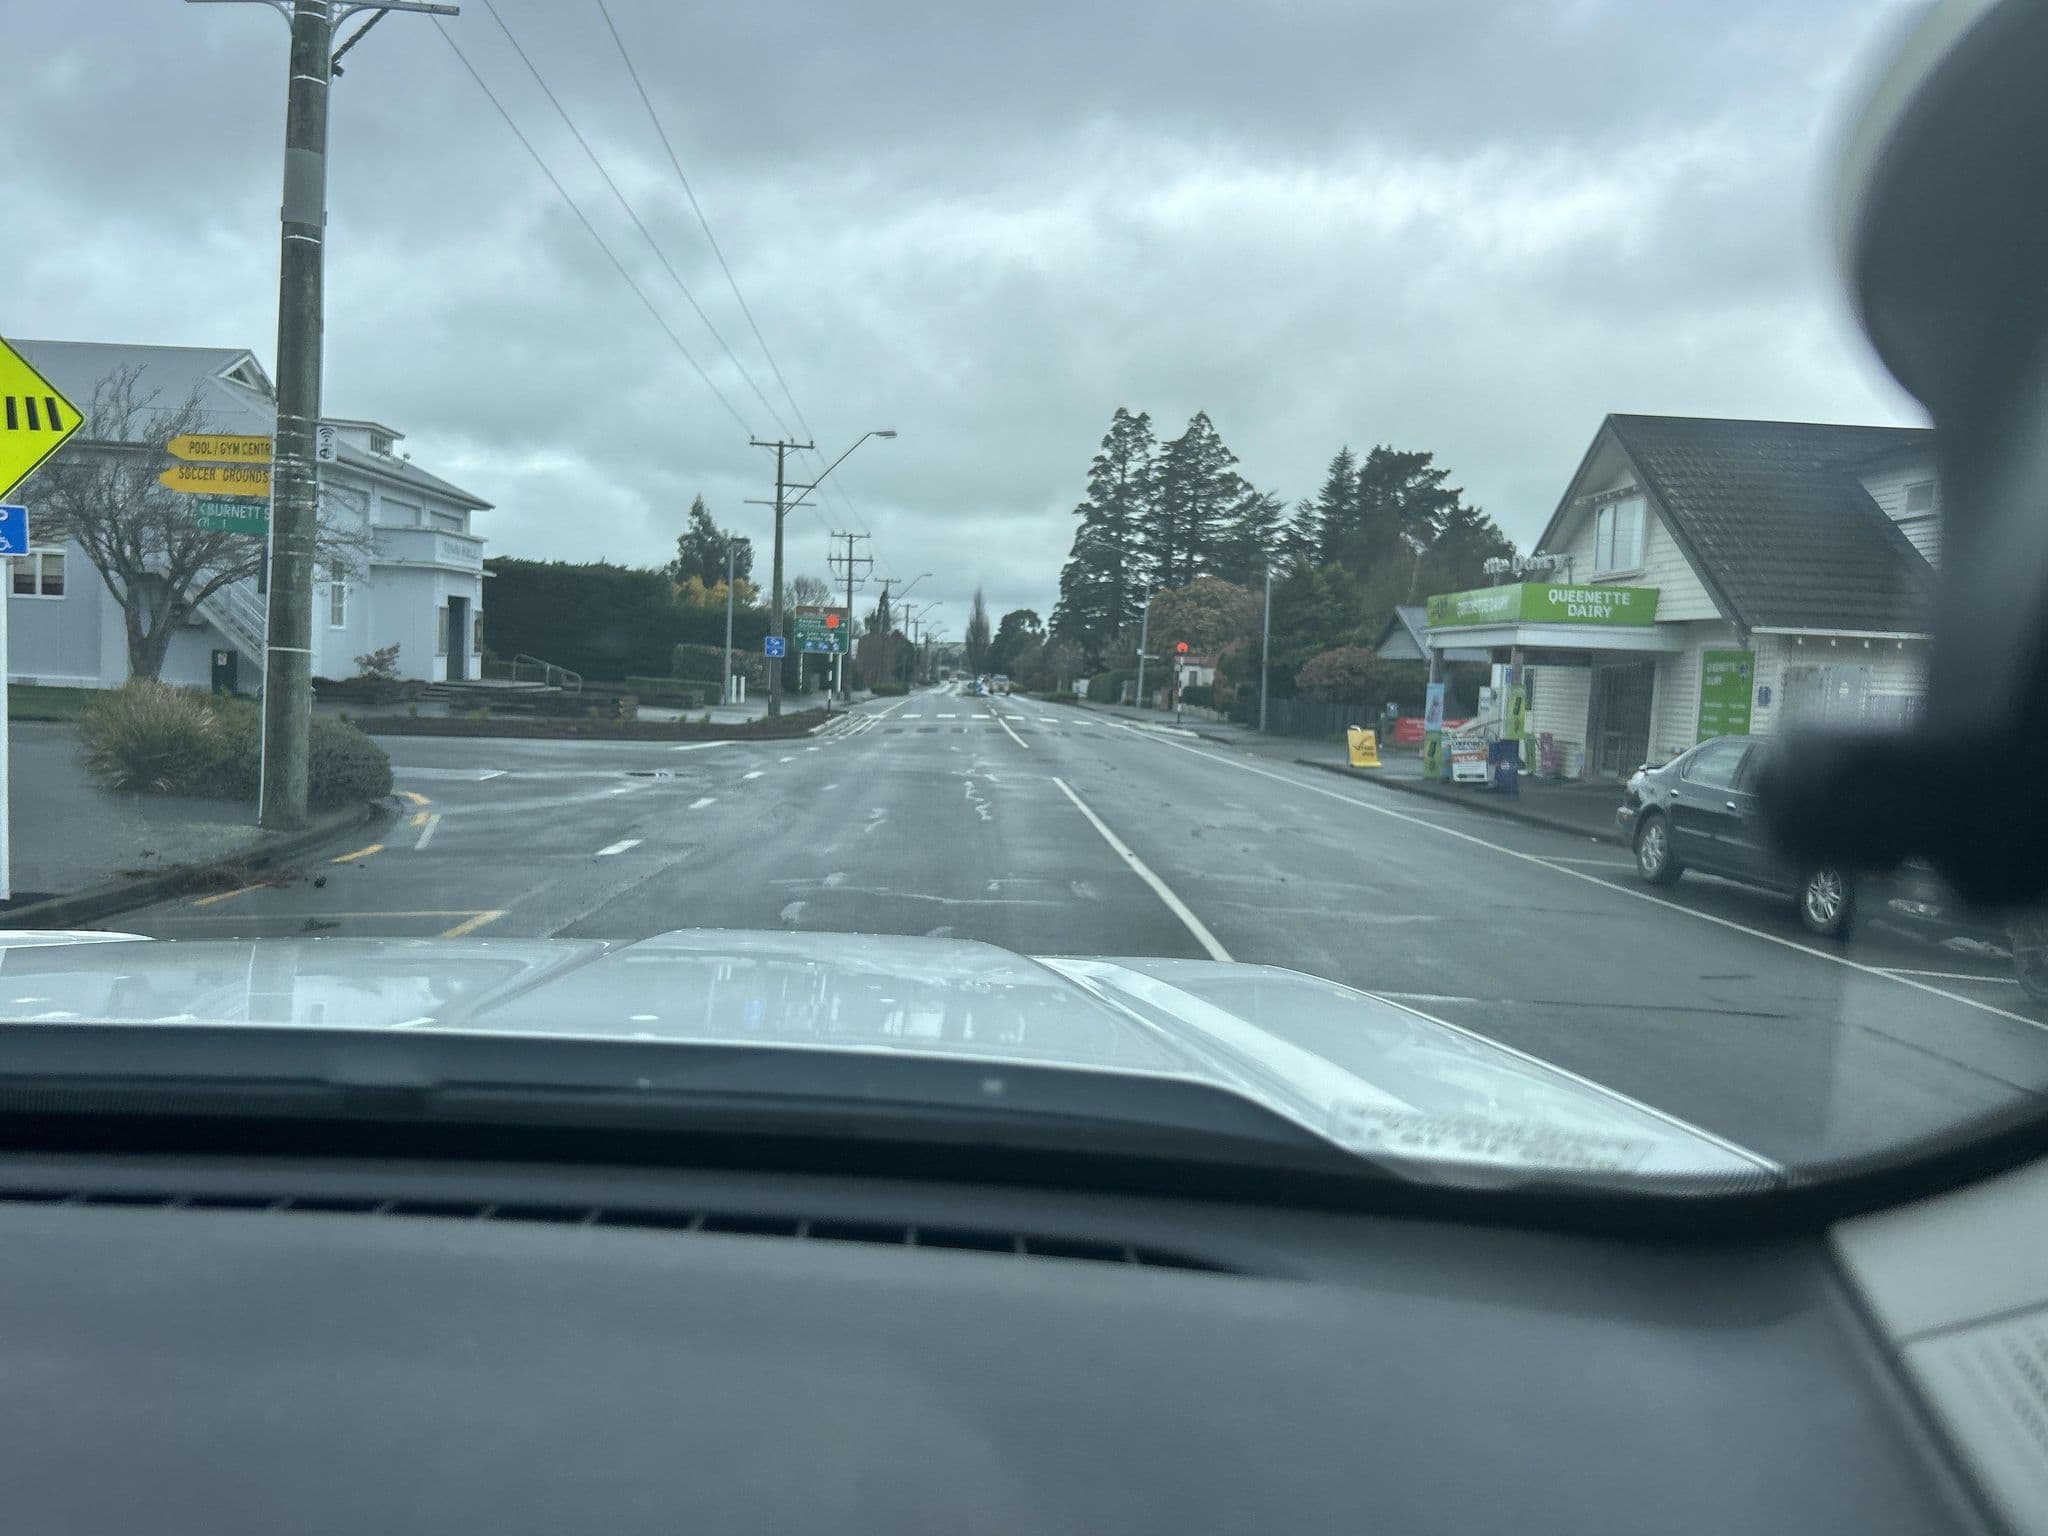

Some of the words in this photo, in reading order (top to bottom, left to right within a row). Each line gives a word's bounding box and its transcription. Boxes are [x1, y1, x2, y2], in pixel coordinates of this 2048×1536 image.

[189, 441, 215, 455] POOL
[220, 442, 241, 455] GYM
[242, 442, 271, 456] CENTR
[178, 466, 216, 481] SOCCER
[222, 469, 269, 484] GROUNDS
[207, 502, 261, 519] BURNETT
[1548, 588, 1631, 606] QUEENETTE
[1567, 604, 1612, 618] DAIRY
